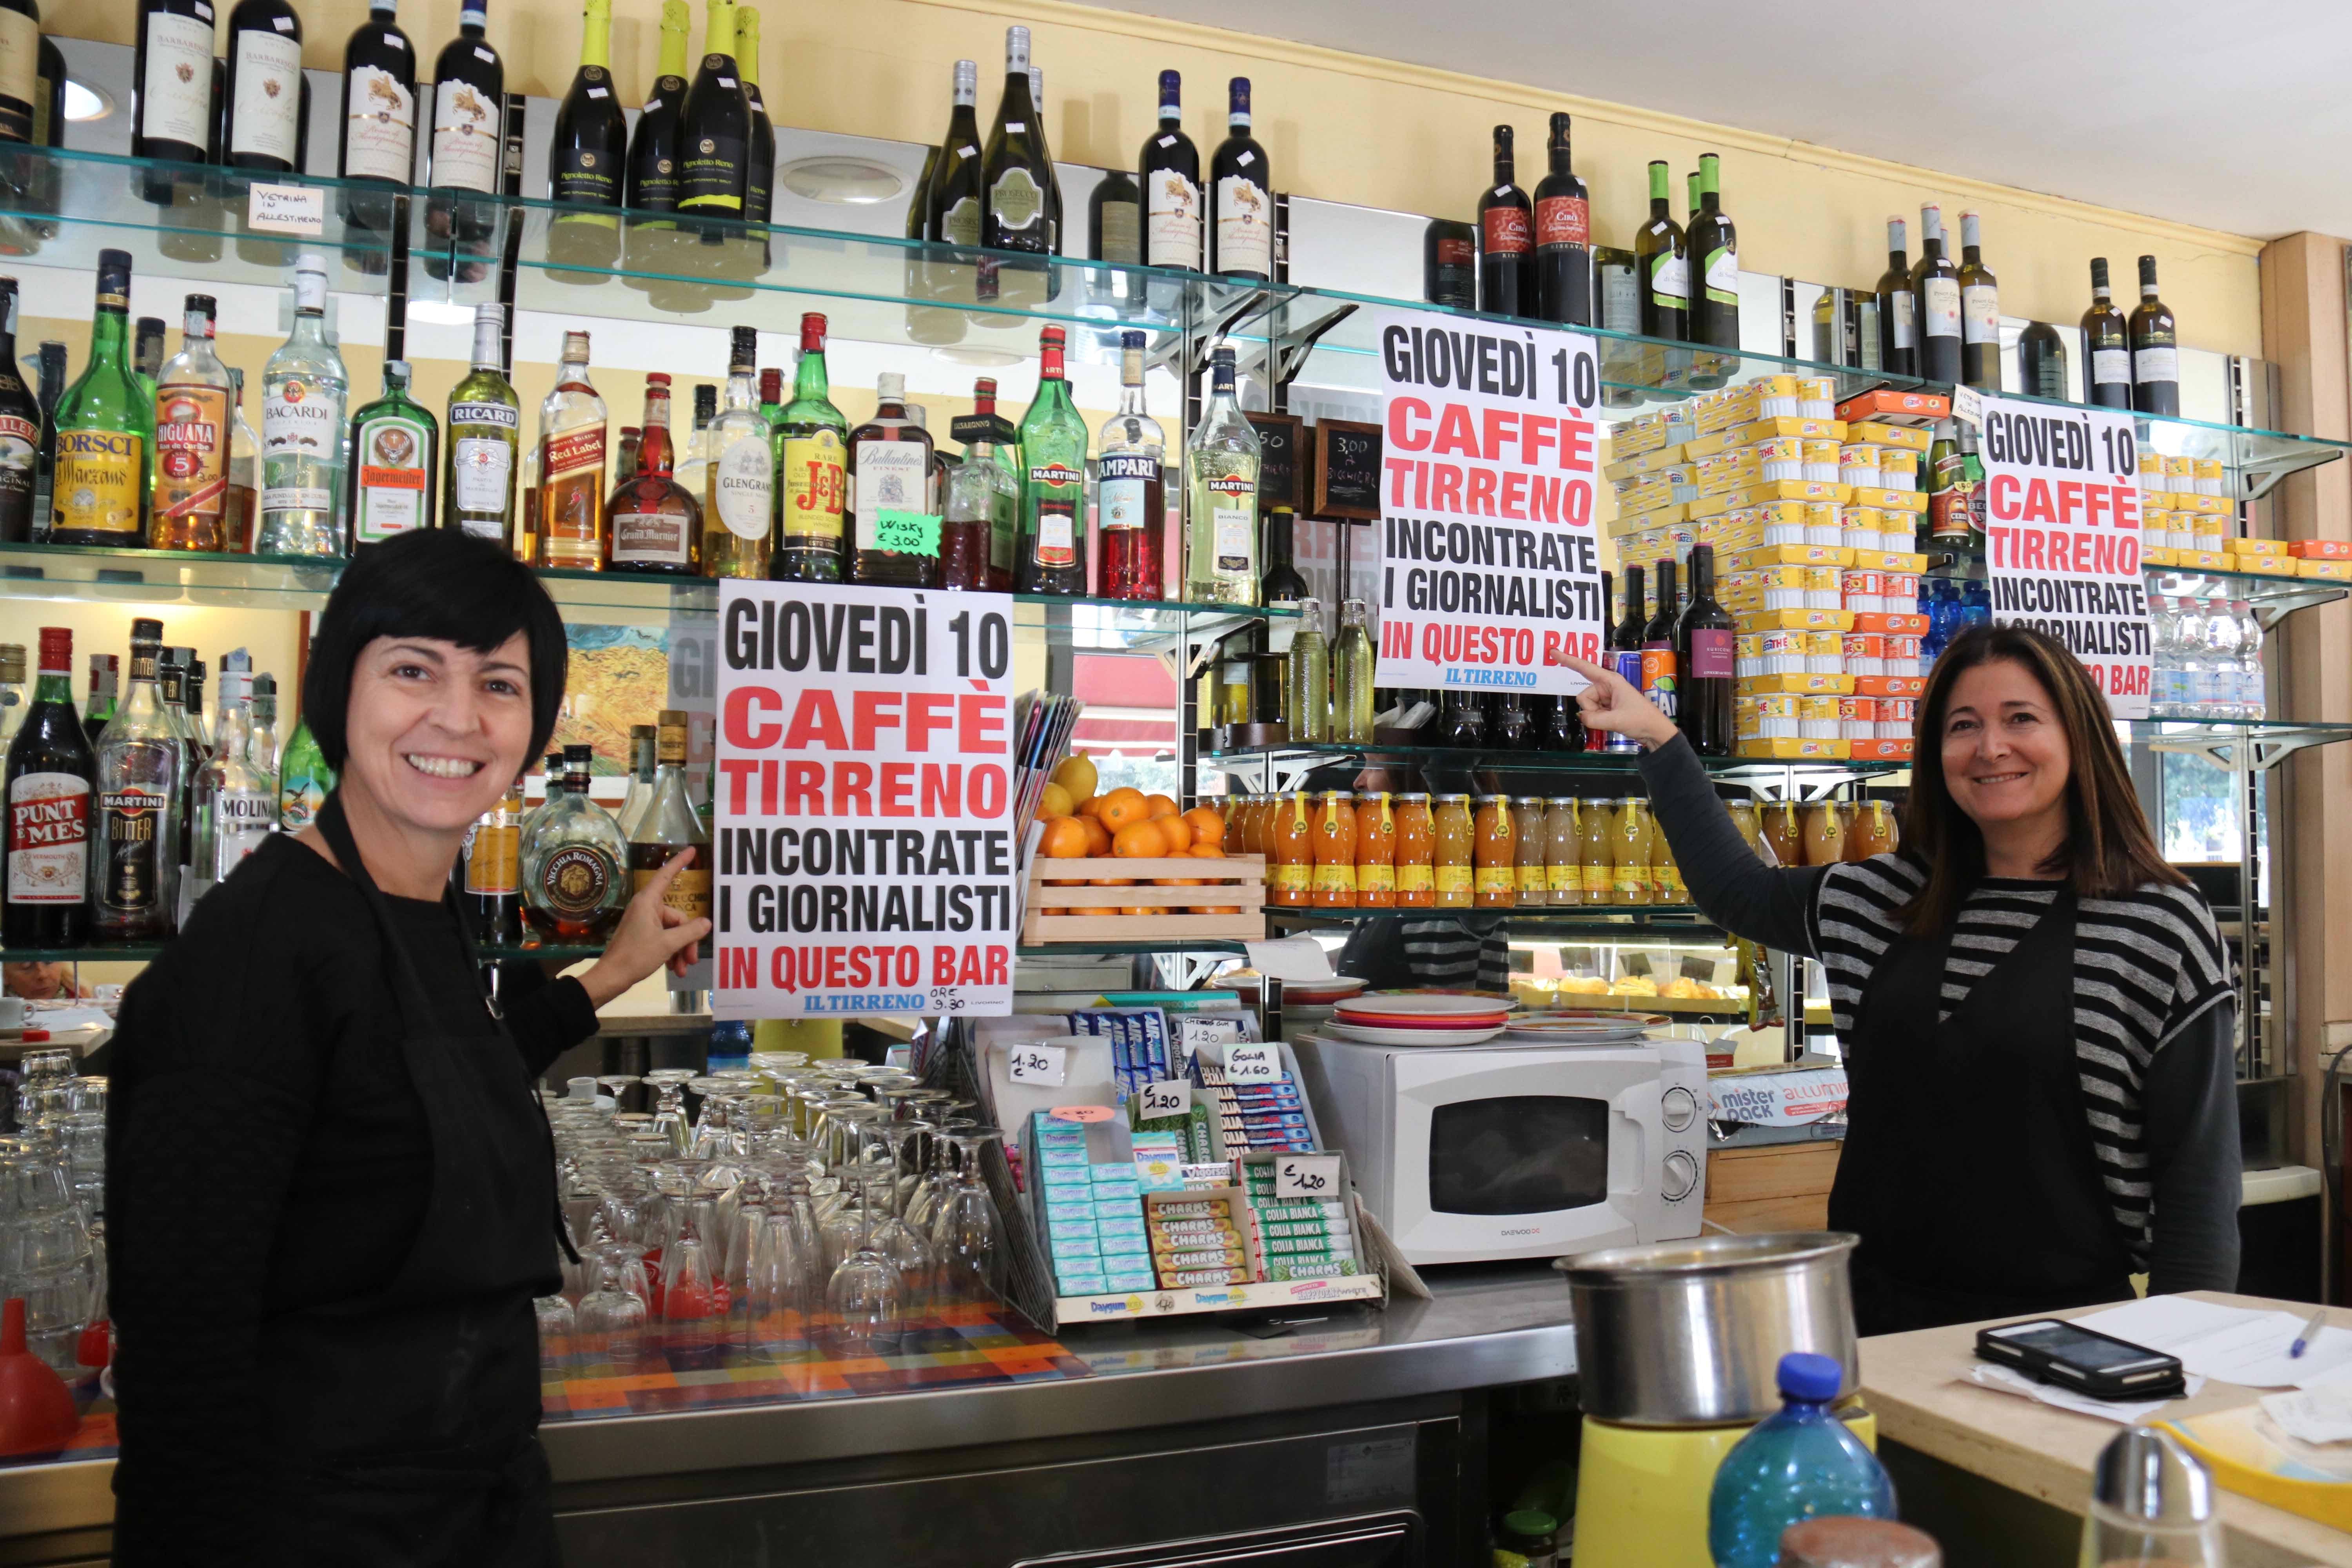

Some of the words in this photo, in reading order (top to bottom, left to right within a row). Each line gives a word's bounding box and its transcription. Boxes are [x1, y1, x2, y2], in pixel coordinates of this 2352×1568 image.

[714, 160, 733, 168] Reno
[595, 172, 612, 184] Reno
[257, 191, 307, 203] VETRINA
[1383, 325, 1537, 400] GIOVEDÌ
[1551, 348, 1595, 409] 10
[266, 405, 328, 420] BACARDI
[454, 407, 515, 423] RICARD
[3, 419, 38, 441] ILEYS
[954, 419, 989, 429] DISARONNO
[158, 423, 213, 444] HIGUANA
[1388, 396, 1594, 473] CAFFÈ
[56, 434, 132, 456] BORSCI
[549, 448, 572, 462] Red
[573, 439, 603, 456] Label
[1338, 437, 1368, 455] 3,00
[1986, 410, 2094, 471] GIOVEDÌ
[2102, 426, 2134, 476] 10
[815, 453, 838, 462] RARE
[858, 445, 923, 466] Ballantine's
[173, 457, 189, 472] 5
[1033, 470, 1080, 482] MARTINI
[1210, 481, 1254, 492] MARTINI
[1385, 457, 1593, 527] TIRRENO
[748, 505, 755, 514] 5
[1990, 474, 2139, 530] CAFFÈ
[620, 528, 643, 540] Grand
[645, 529, 678, 542] Marnier
[880, 520, 923, 538] Wisky
[878, 533, 886, 541] €
[891, 535, 920, 546] 3.00
[1386, 517, 1598, 575] INCONTRATE
[1988, 526, 2139, 576] TIRRENO
[1384, 567, 1394, 608] I
[1407, 567, 1600, 621] GIORNALISTI
[1992, 576, 2147, 616] INCONTRATE
[724, 593, 927, 675] GIOVEDÌ
[948, 610, 1009, 679] 10
[1382, 621, 1413, 659] IN
[1422, 622, 1532, 667] QUESTO
[1543, 630, 1600, 666] BAR
[1445, 668, 1464, 685] IL
[1463, 669, 1537, 687] TIRRENO
[2110, 664, 2149, 695] BAR
[723, 679, 1007, 754] CAFFÈ
[720, 759, 1007, 819] TIRRENO
[103, 796, 162, 807] MARTINI
[14, 799, 76, 826] PUNT
[16, 828, 25, 839] E
[26, 819, 85, 844] MES
[111, 817, 151, 841] BITTER
[720, 828, 1010, 876] INCONTRATE
[547, 854, 572, 885] VECCHIA
[572, 851, 603, 886] ROMAGNA
[719, 885, 730, 933] I
[748, 885, 1011, 933] GIORNALISTI
[718, 947, 757, 990] IN
[771, 945, 920, 995] QUESTO
[932, 945, 1009, 986] BAR
[930, 988, 958, 998] ORE
[804, 995, 827, 1012] IL
[826, 994, 925, 1011] TIRRENO
[932, 998, 965, 1011] 9.30
[1127, 1018, 1143, 1042] AIR
[1145, 1014, 1160, 1038] AIR
[1190, 1030, 1219, 1044] 1.20
[1011, 1053, 1048, 1070] 1.20
[1171, 1033, 1185, 1079] Vigorsol
[1232, 1049, 1265, 1062] GOLIA
[1240, 1066, 1269, 1076] 1.60
[1144, 1085, 1154, 1097] €
[1722, 1088, 1775, 1108] mister
[1145, 1095, 1180, 1109] 1.20
[1263, 1114, 1281, 1123] PLUS
[1726, 1104, 1774, 1123] pack
[1046, 1134, 1078, 1144] Daygum
[1137, 1152, 1176, 1162] Daygum
[1186, 1166, 1231, 1179] Vigorsol
[1284, 1164, 1296, 1176] €
[1293, 1174, 1325, 1190] 1,20
[1158, 1202, 1211, 1215] CHARMS
[1258, 1196, 1279, 1208] GOLIA
[1266, 1209, 1289, 1221] GOLIA
[1290, 1207, 1318, 1220] BIANCA
[1161, 1220, 1214, 1232] CHARMS
[1269, 1225, 1291, 1237] GOLIA
[1293, 1223, 1321, 1236] BIANCA
[1170, 1233, 1225, 1247] CHARMS
[1272, 1241, 1294, 1253] GOLIA
[1296, 1239, 1324, 1251] BIANCA
[1172, 1251, 1226, 1265] CHARMS
[1176, 1270, 1230, 1285] CHARMS
[1289, 1263, 1341, 1277] CHARMS
[1195, 1292, 1229, 1304] Daygum
[1090, 1301, 1126, 1314] Daygum
